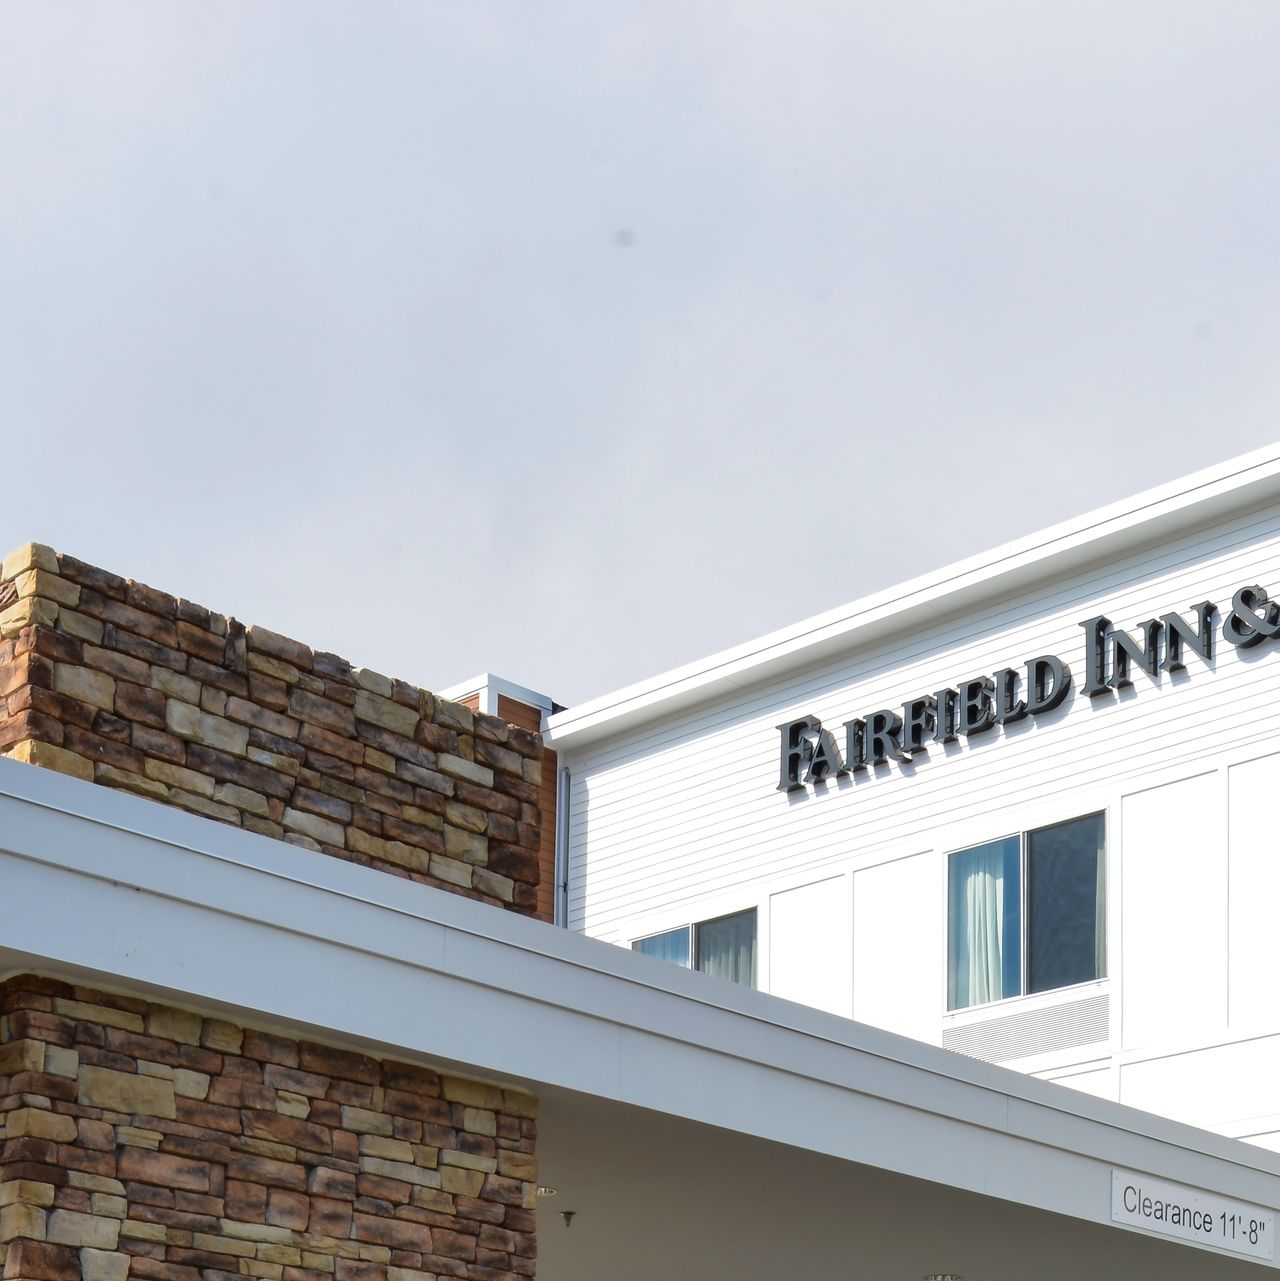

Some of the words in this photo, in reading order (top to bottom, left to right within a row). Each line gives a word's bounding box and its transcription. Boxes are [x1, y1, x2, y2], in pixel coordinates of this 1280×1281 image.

[776, 654, 1072, 794] FAIRFIELD
[1079, 600, 1218, 698] INN
[1123, 1186, 1213, 1232] Clearance
[1220, 1212, 1265, 1245] 11'-8"
